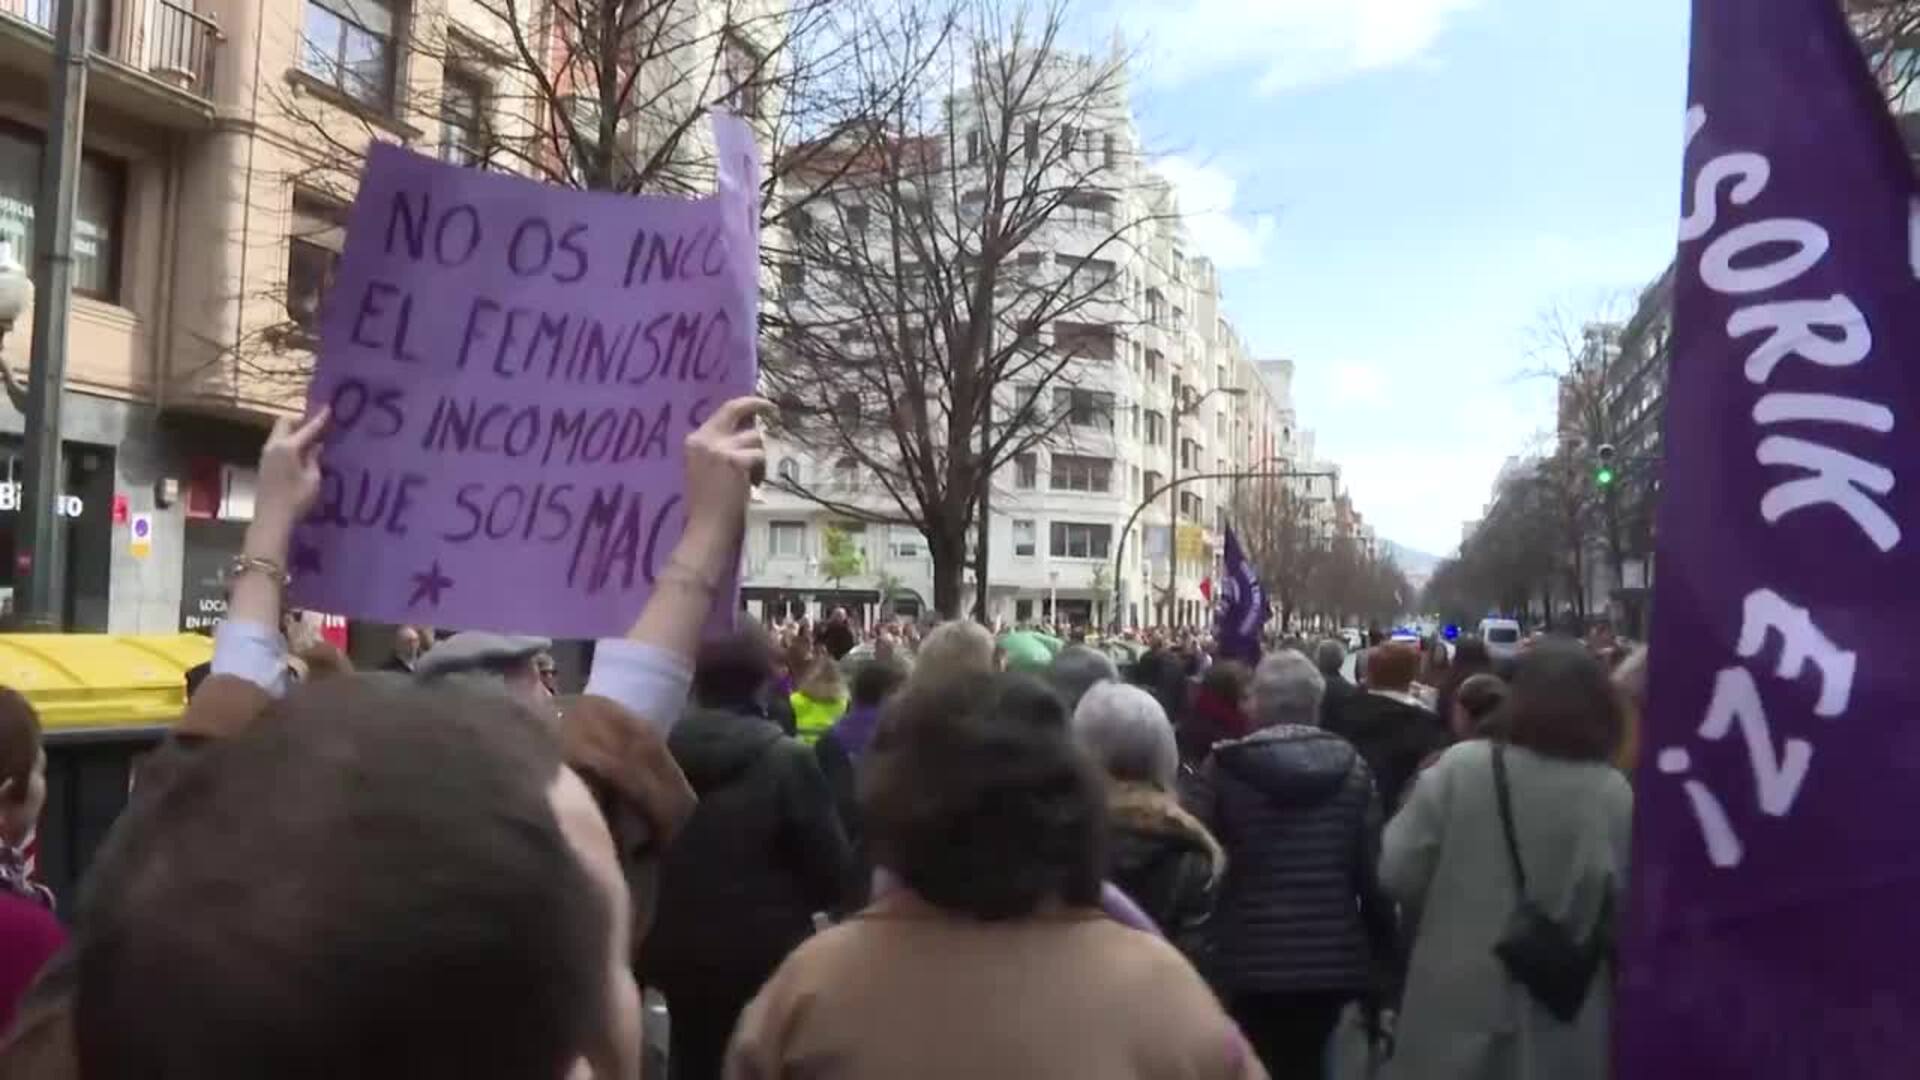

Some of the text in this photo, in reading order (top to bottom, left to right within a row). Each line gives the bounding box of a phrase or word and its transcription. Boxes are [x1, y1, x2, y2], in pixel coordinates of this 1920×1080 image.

[384, 190, 482, 269] NO
[507, 217, 589, 284] OS
[350, 281, 423, 364] EL
[330, 375, 403, 439] OS
[420, 394, 673, 466] INCOMODA
[440, 483, 575, 544] SOIS
[1656, 104, 1902, 869] SORIK EZ!
